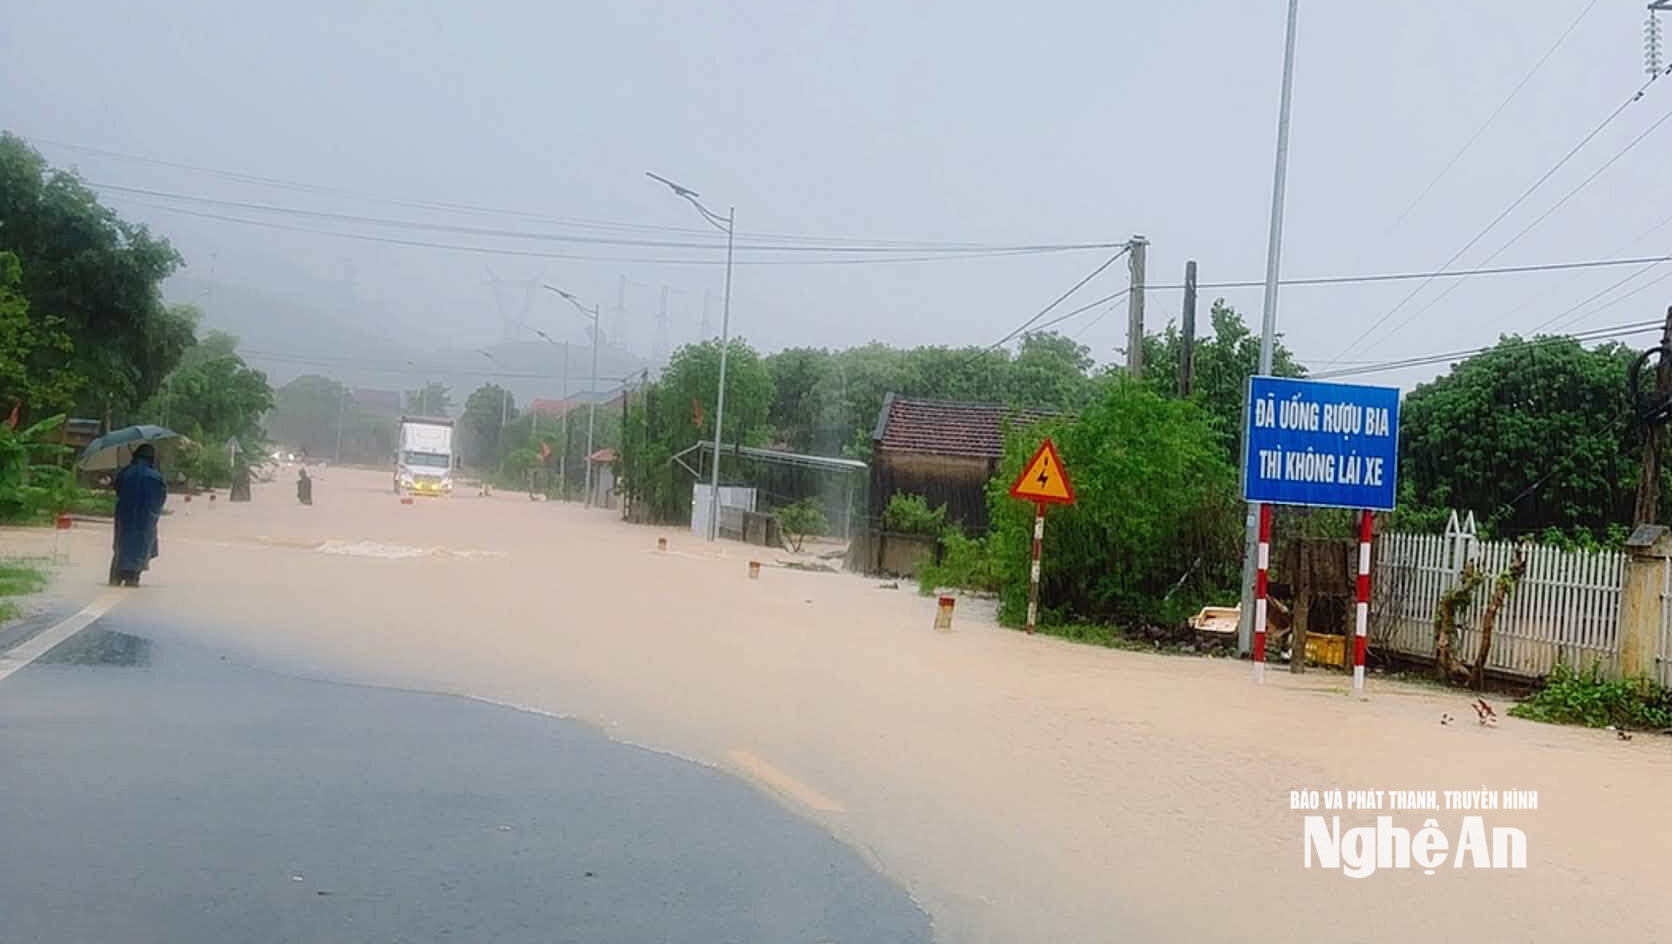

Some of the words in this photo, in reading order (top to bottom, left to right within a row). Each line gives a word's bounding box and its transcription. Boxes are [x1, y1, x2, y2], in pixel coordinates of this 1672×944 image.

[1279, 392, 1320, 431] UỐNG
[1323, 402, 1362, 440] RƯỢU
[1365, 407, 1389, 436] BIA
[1259, 444, 1281, 480] THÌ
[1285, 446, 1335, 482] KHÔNG
[1338, 450, 1360, 485] LÁI
[1363, 457, 1384, 486] XE
